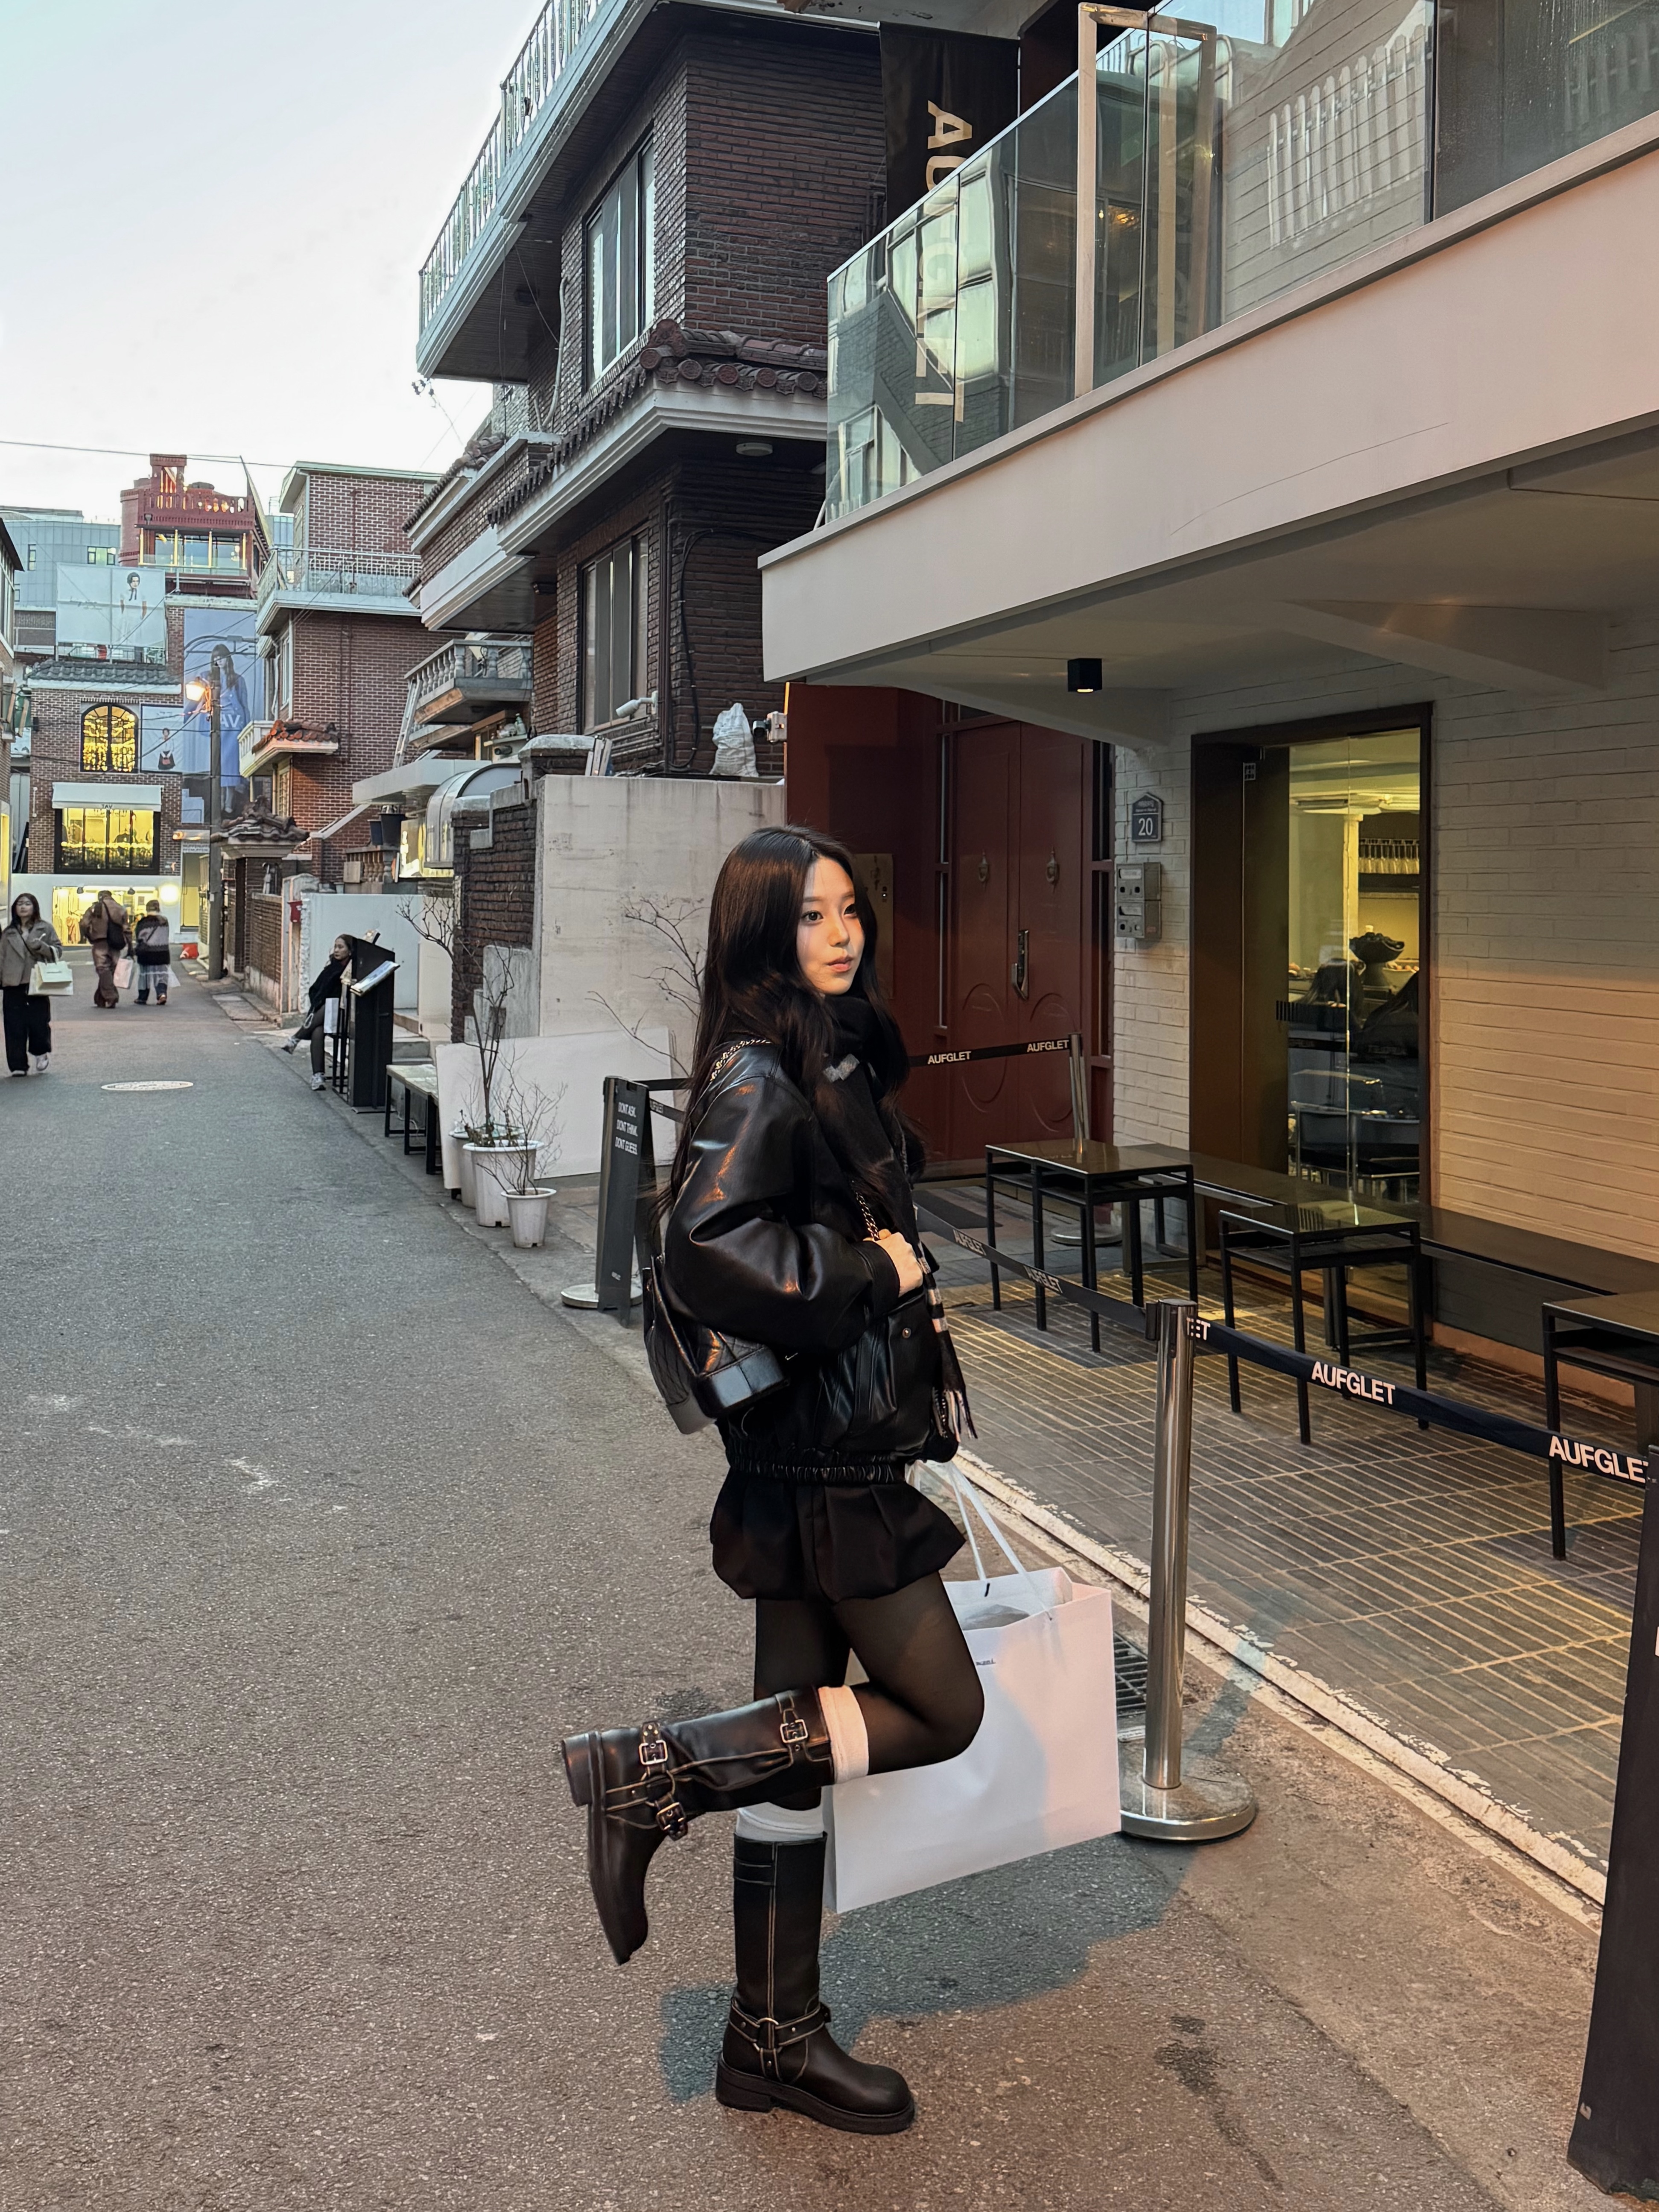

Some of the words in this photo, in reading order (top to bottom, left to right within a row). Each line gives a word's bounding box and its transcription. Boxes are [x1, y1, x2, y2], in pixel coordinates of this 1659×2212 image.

[220, 714, 241, 728] AV
[1138, 817, 1153, 836] 20
[1026, 1039, 1069, 1053] AUFGLET
[927, 1050, 972, 1065] AUFGLET
[953, 1229, 987, 1255] AUFGLET
[1023, 1265, 1063, 1293] AUFGLET
[1311, 1361, 1396, 1405] AUFGLET
